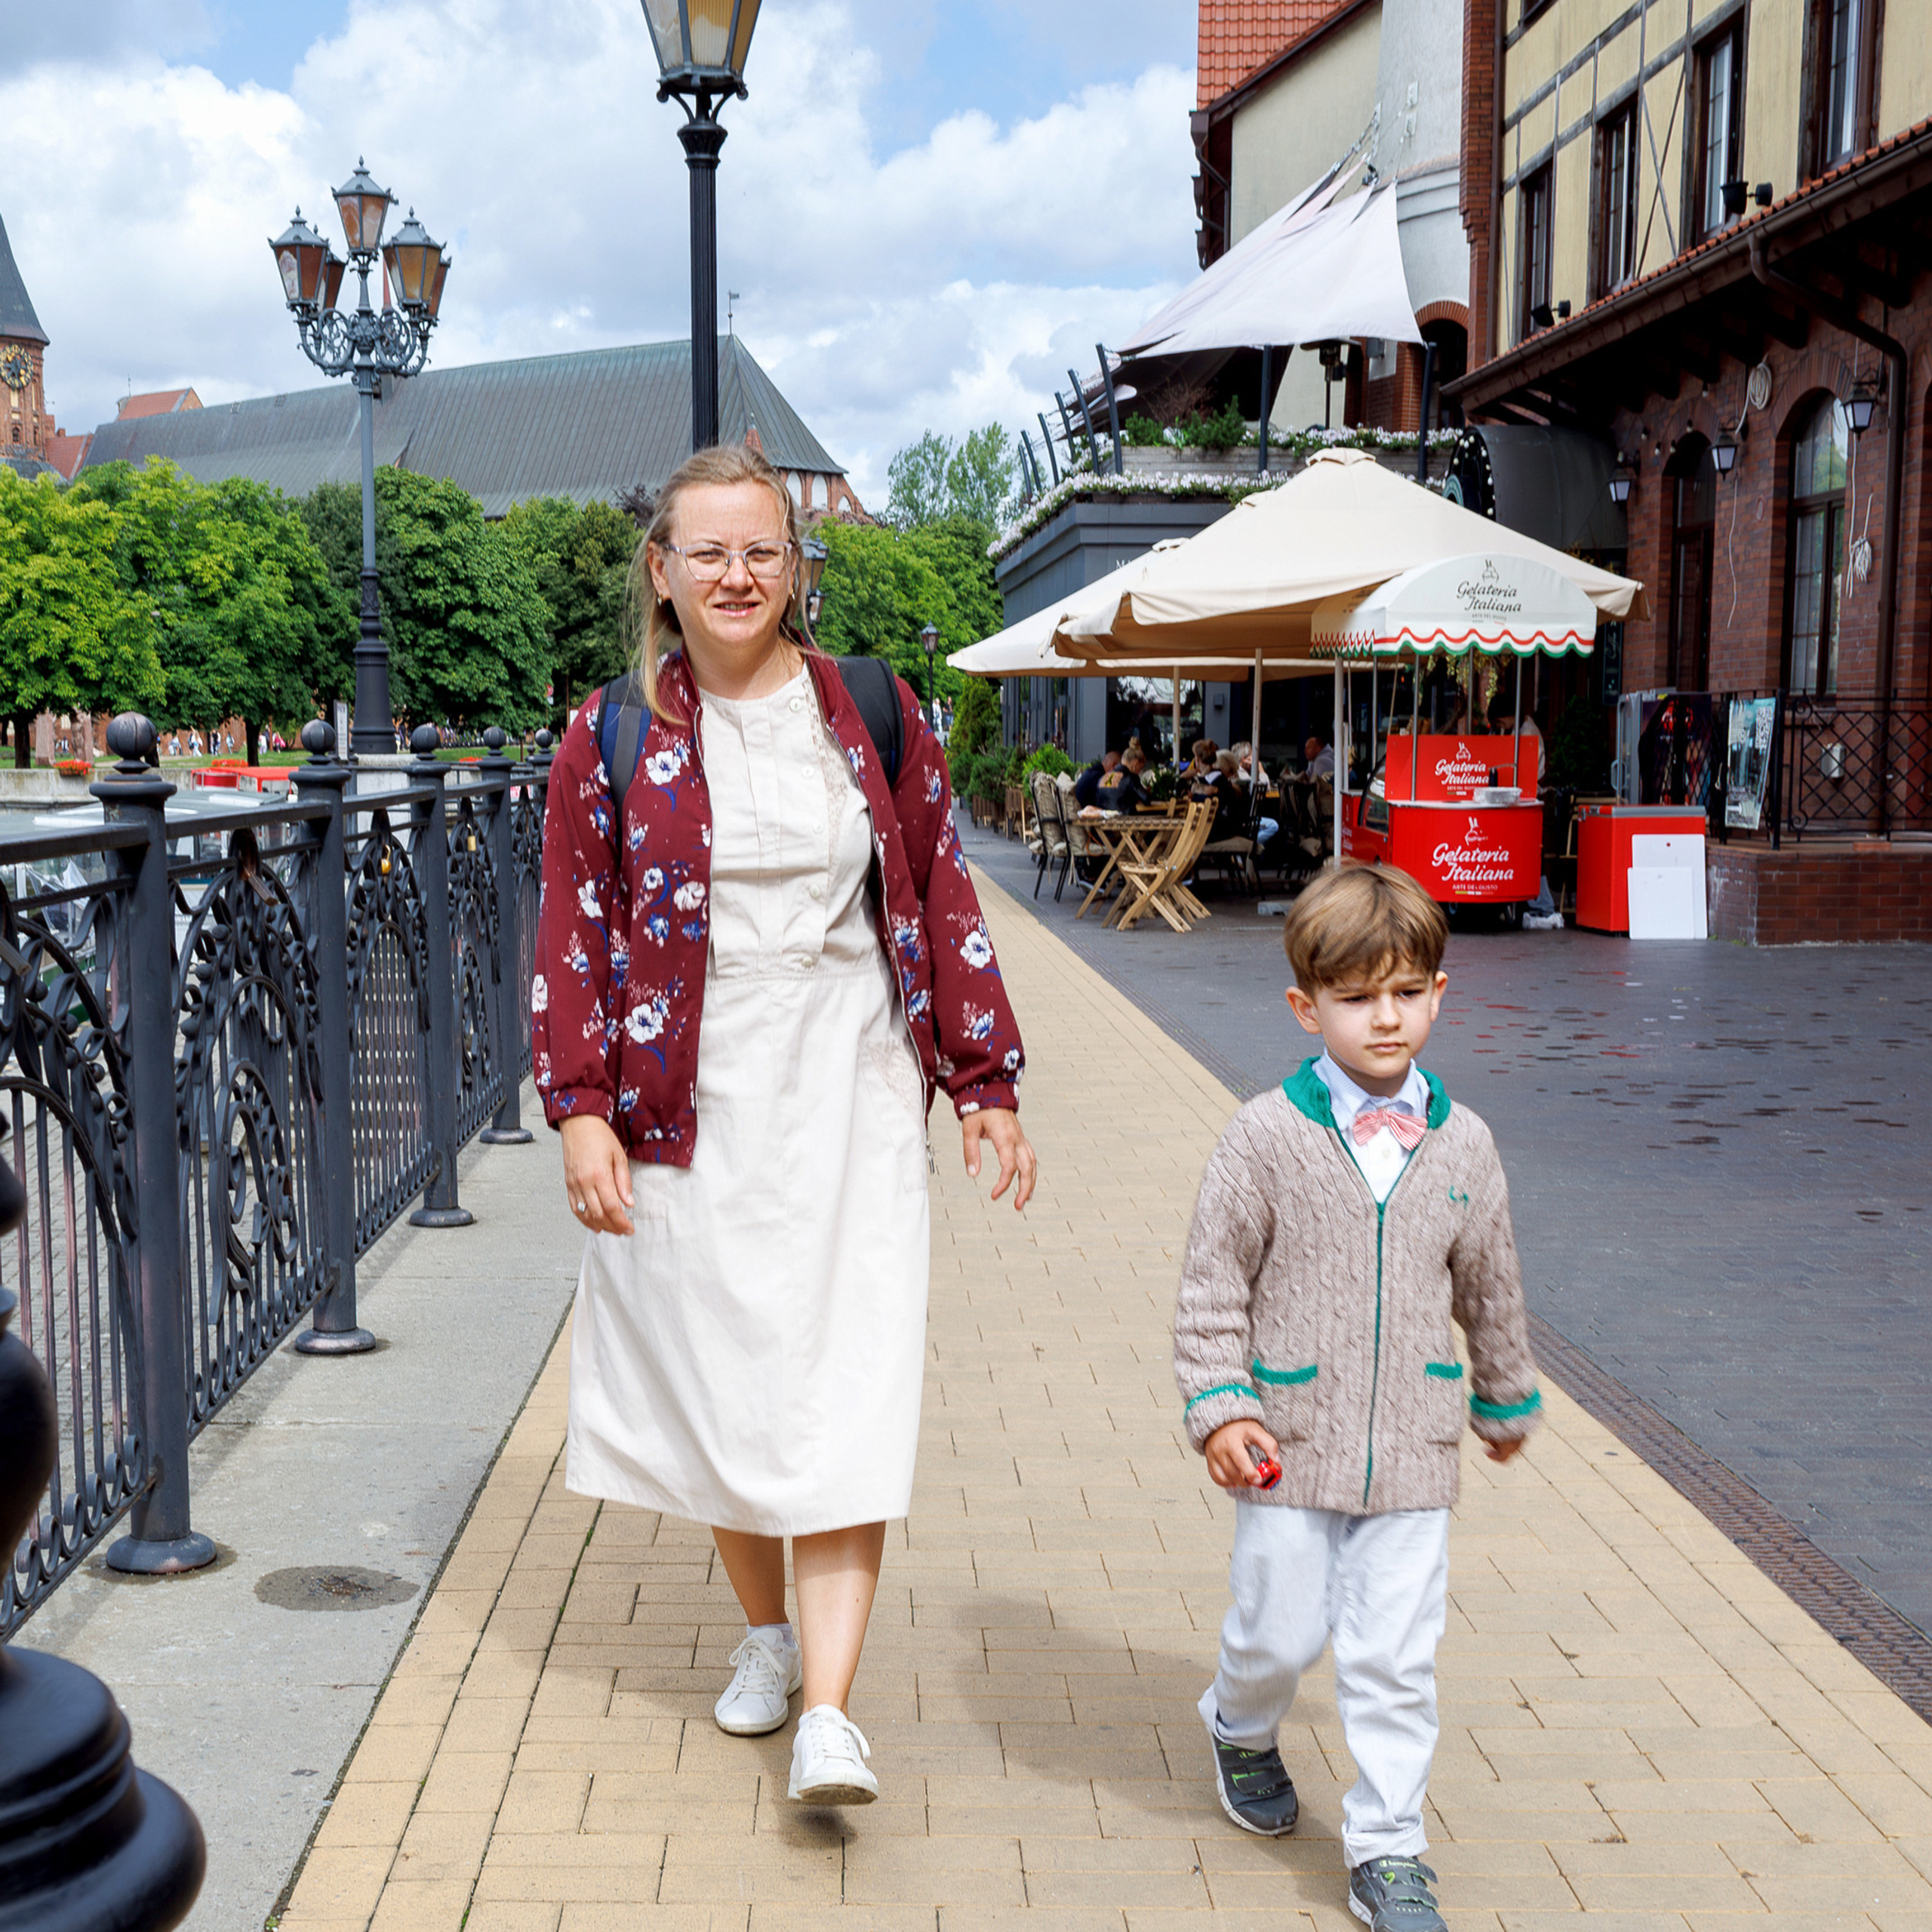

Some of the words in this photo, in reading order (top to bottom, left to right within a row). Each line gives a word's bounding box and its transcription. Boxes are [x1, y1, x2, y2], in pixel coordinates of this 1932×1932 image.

[1457, 580, 1517, 598] Gelateria
[1464, 595, 1521, 612] Italiana
[1435, 758, 1486, 776] Gelateria
[1441, 771, 1489, 785] Italiana
[1432, 843, 1509, 867] Gelateria
[1441, 862, 1514, 881] Italiana
